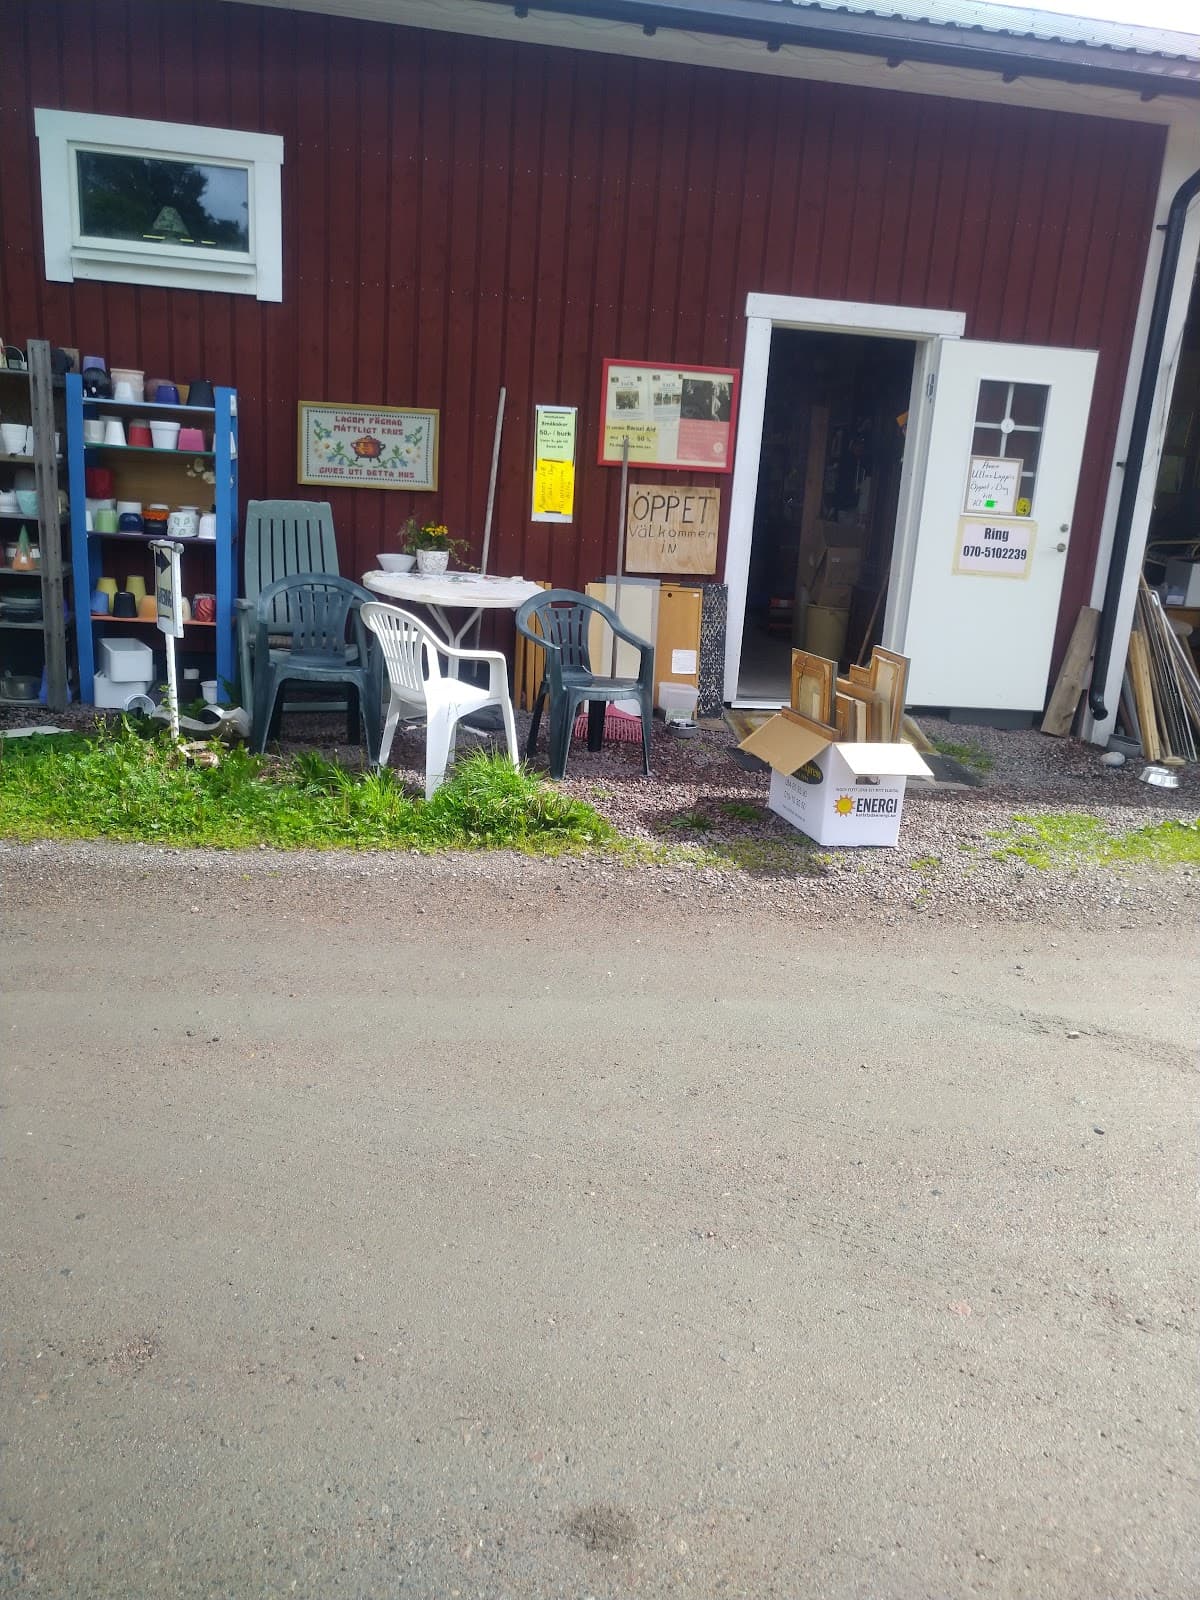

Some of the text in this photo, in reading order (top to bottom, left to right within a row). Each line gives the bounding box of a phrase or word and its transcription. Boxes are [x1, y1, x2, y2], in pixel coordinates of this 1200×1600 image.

[335, 415, 365, 425] LAGOM
[333, 424, 404, 436] MÅTTLIGT KRUS
[319, 466, 415, 479] GIVES UTI DETTA HUS
[632, 491, 717, 525] ÖPPET
[984, 527, 1010, 543] Ring
[963, 545, 1028, 561] 070-5102239
[856, 797, 898, 814] ENERGI
